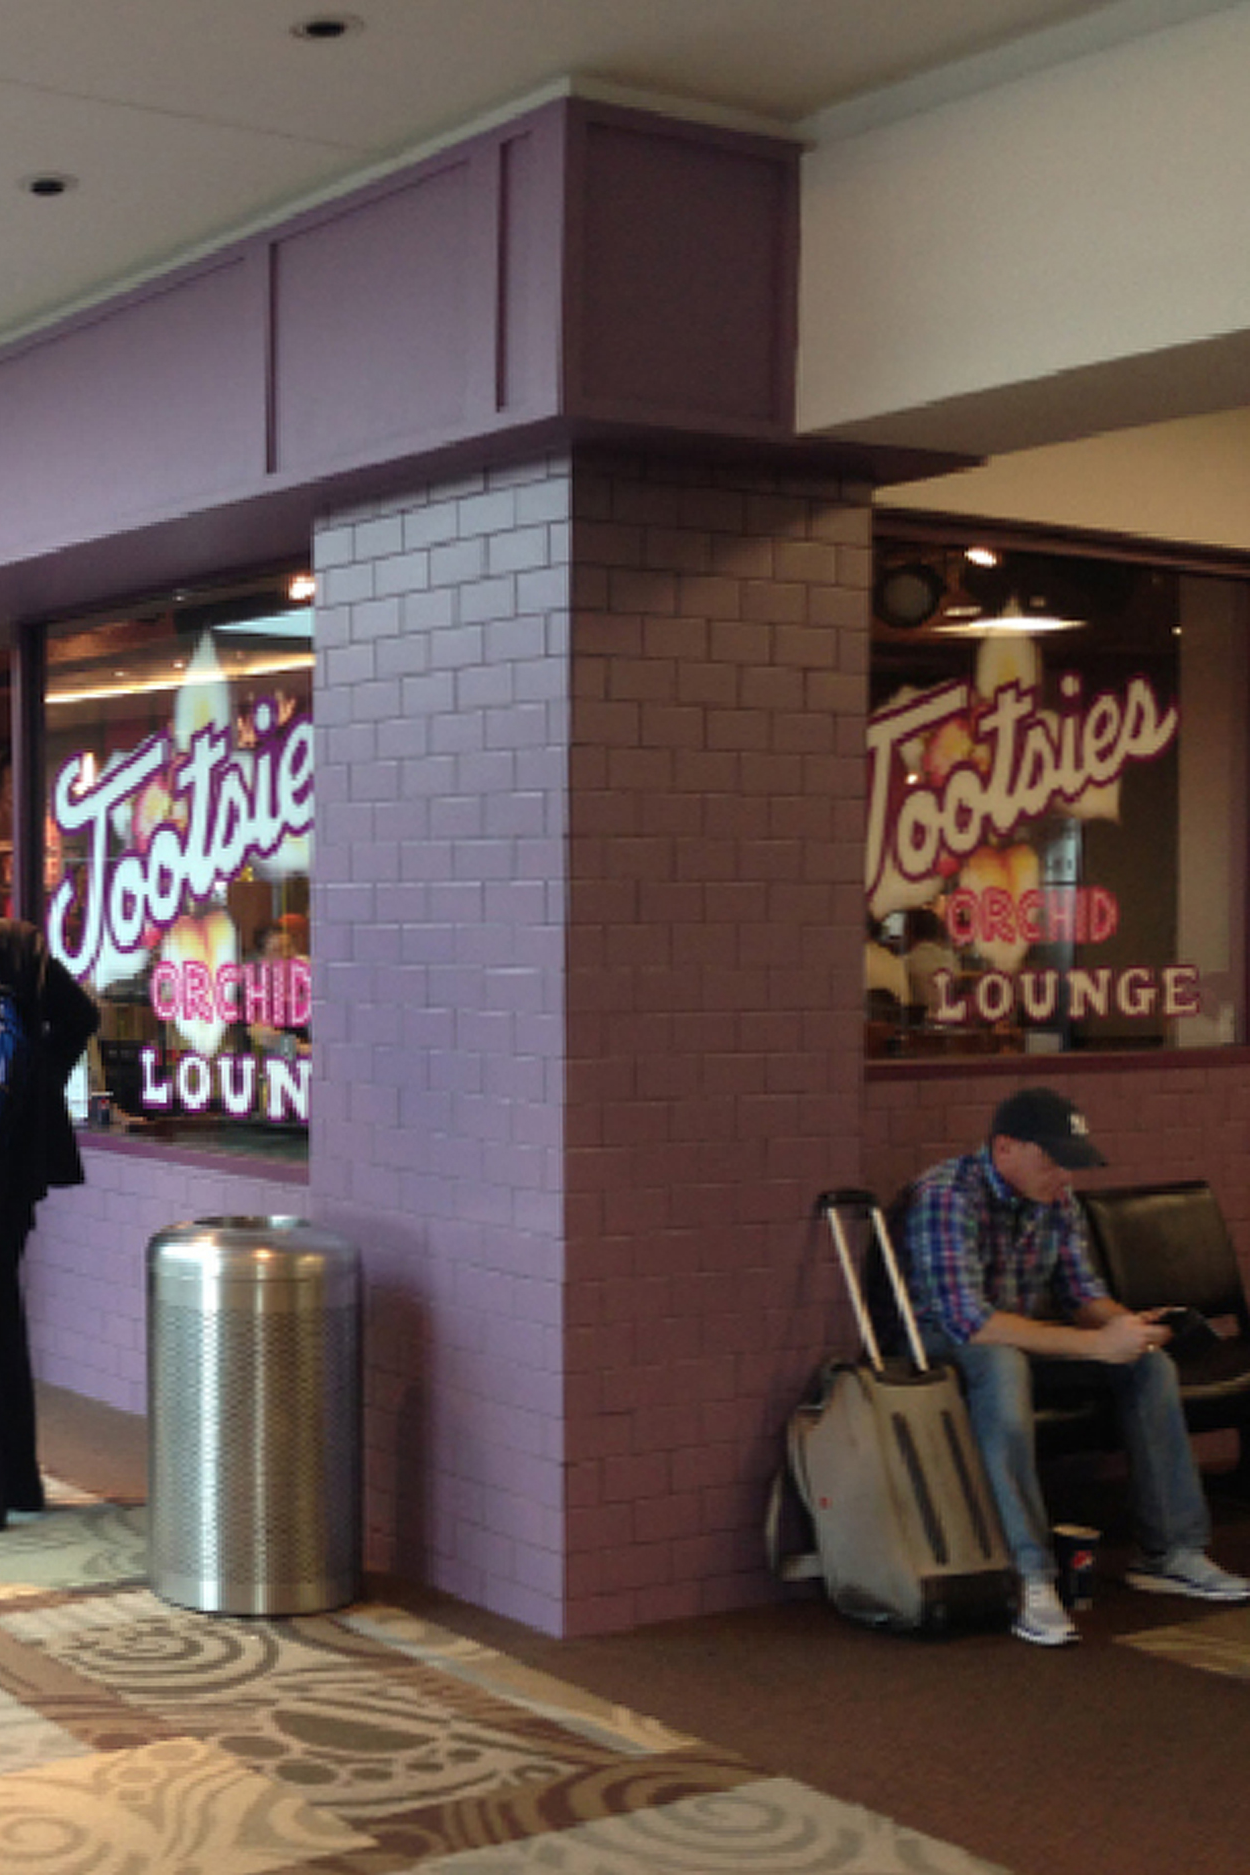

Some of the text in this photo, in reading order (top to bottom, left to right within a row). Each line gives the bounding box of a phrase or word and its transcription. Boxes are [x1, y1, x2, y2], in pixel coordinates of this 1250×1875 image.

[946, 887, 1119, 945] ORCHID
[152, 959, 314, 1029] ORCHID
[932, 964, 1202, 1022] LOUNGE
